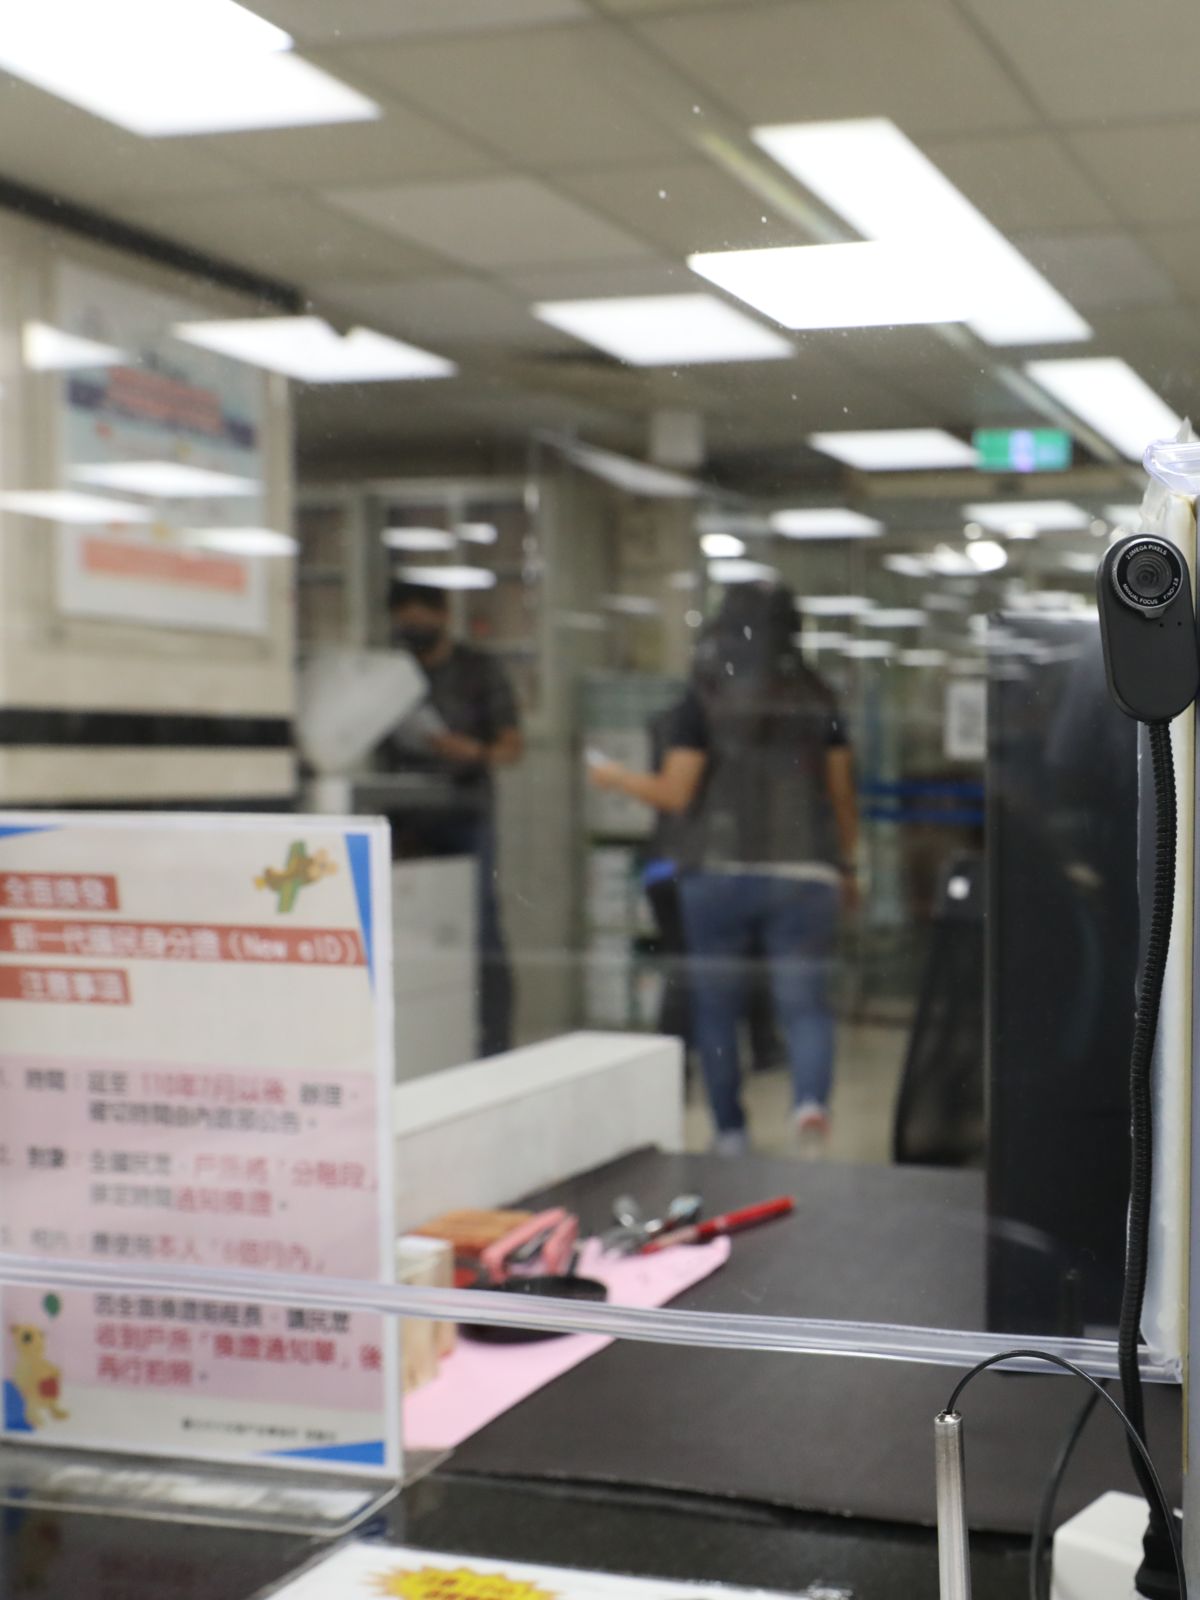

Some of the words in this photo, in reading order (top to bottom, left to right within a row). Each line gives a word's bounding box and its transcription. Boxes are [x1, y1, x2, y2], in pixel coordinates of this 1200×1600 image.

[1148, 544, 1168, 556] PIXELS
[1122, 583, 1139, 602] MANUAL
[1139, 597, 1159, 605] FOCUS
